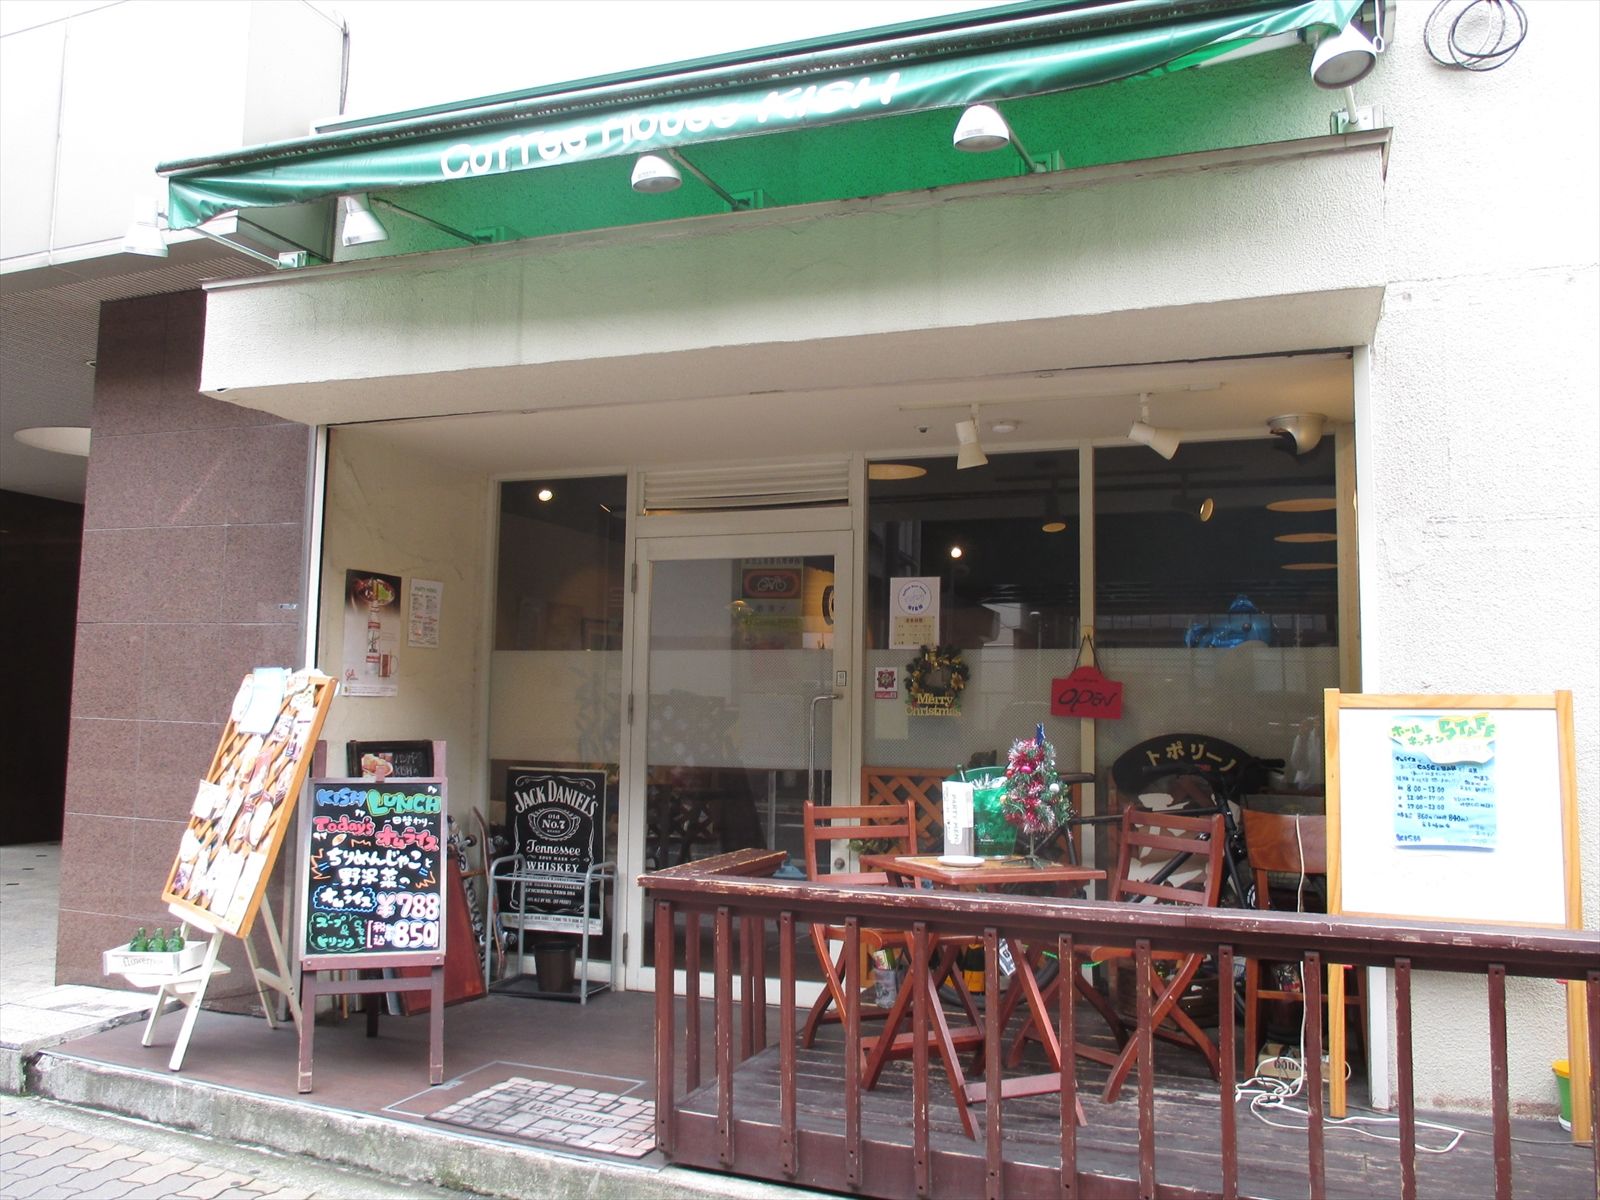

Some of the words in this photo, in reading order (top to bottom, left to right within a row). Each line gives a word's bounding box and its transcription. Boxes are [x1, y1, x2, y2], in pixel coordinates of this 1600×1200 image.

[441, 126, 587, 178] Coffee
[755, 72, 900, 123] KISH
[917, 693, 953, 707] Merry
[1146, 740, 1237, 772] トポリーノ
[316, 787, 366, 807] KISH
[366, 788, 441, 816] LUNCH
[514, 786, 546, 814] JACK
[548, 780, 598, 817] DANIEL'S
[313, 815, 376, 837] Today's
[541, 819, 565, 830] No.7
[375, 824, 440, 851] オムライス
[526, 839, 581, 856] Tennessee
[526, 861, 580, 873] WHISKEY
[376, 892, 440, 920] ¥788
[316, 916, 347, 928] スープ
[317, 934, 355, 948] ドリンク
[529, 1102, 615, 1125] Welcome
